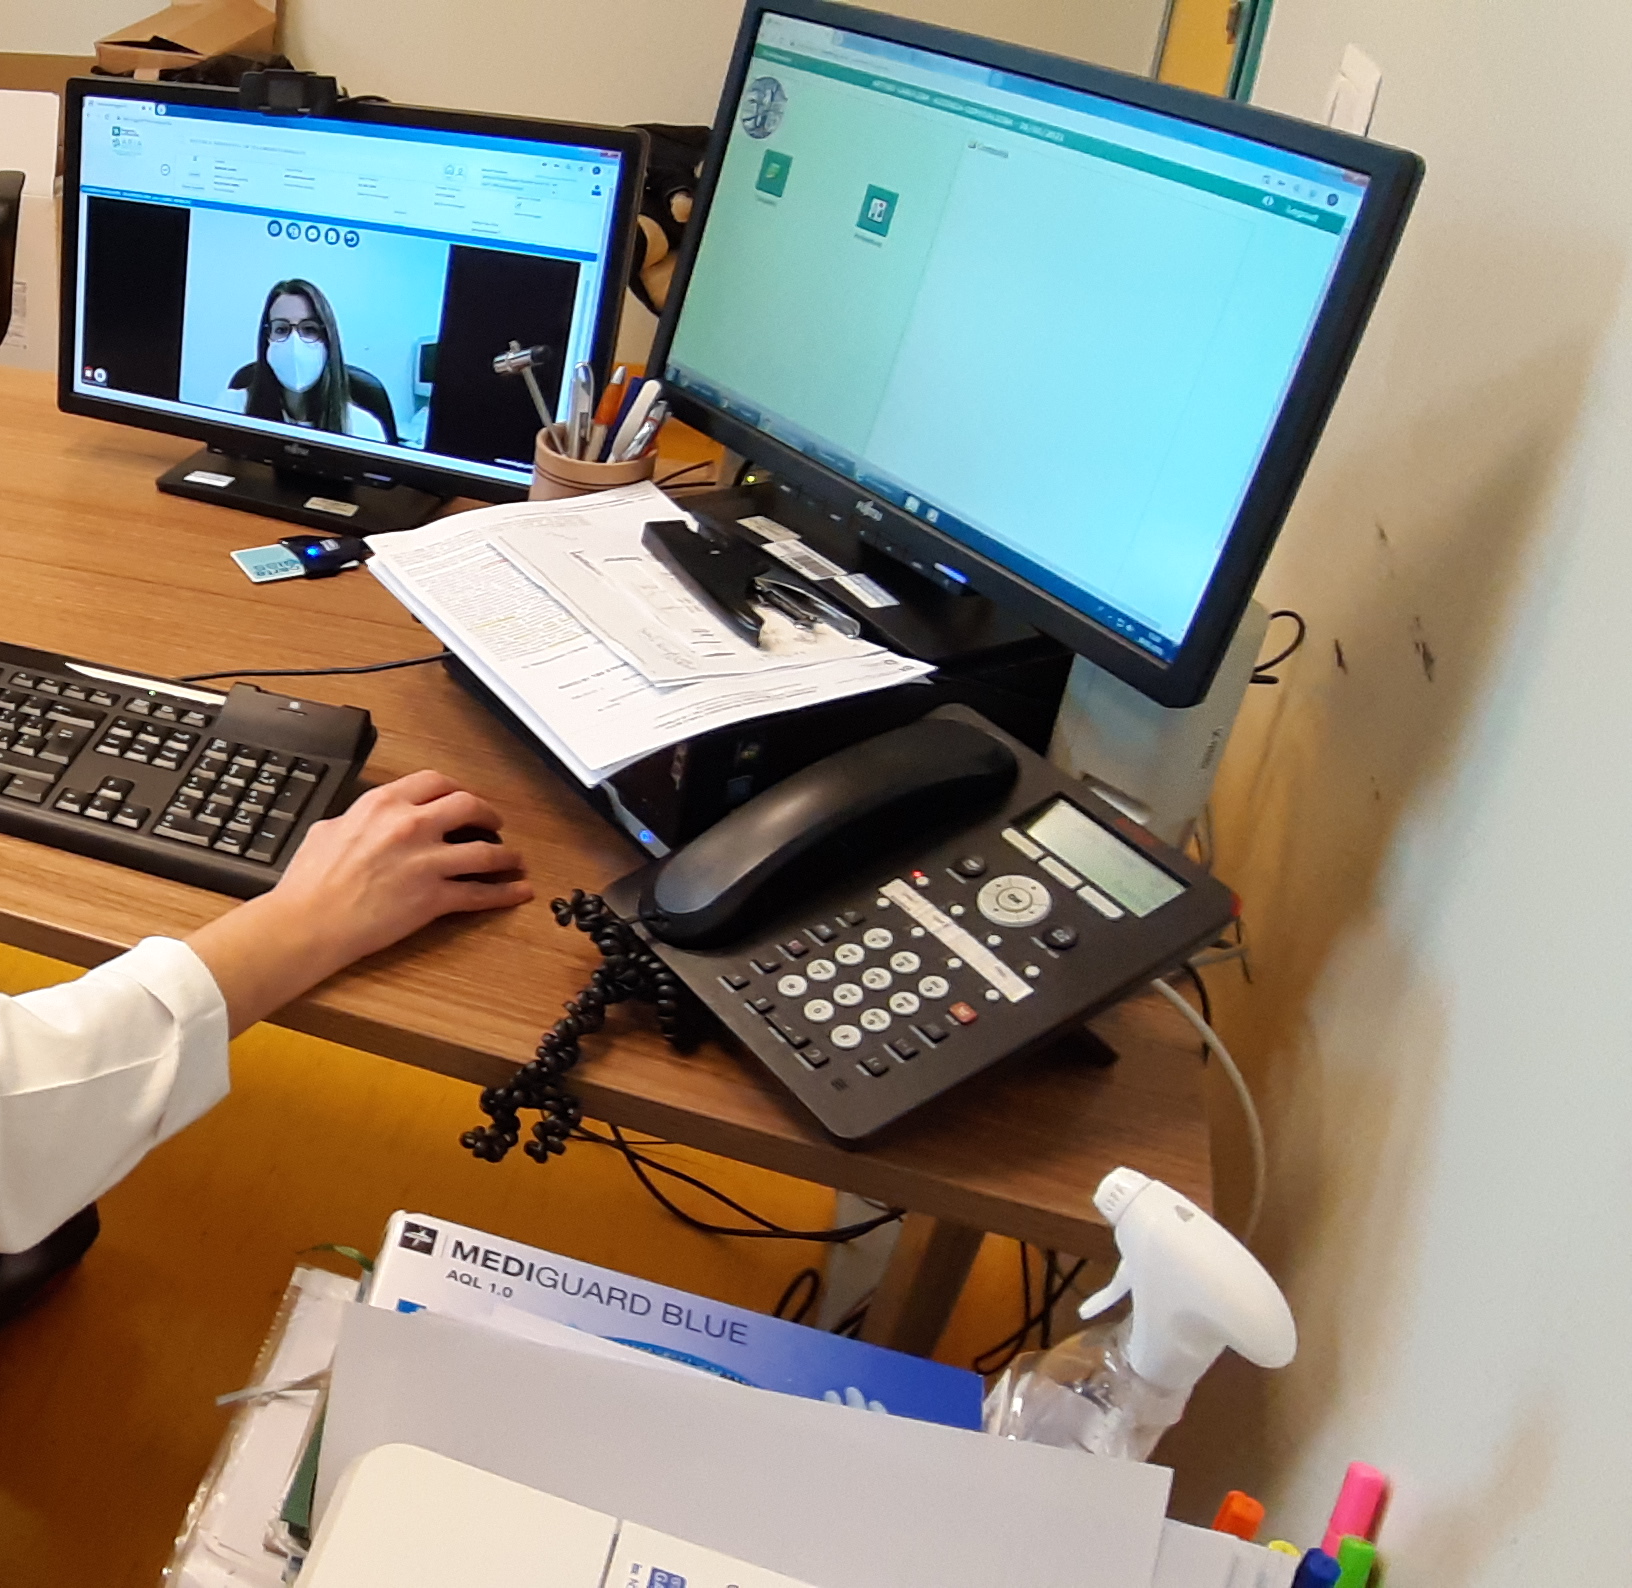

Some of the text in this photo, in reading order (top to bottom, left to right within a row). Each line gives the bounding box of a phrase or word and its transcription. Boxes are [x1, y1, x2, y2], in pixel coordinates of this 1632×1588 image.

[445, 1268, 514, 1299] AQL 1.0
[452, 1239, 749, 1346] MEDIGUARD BLUE
